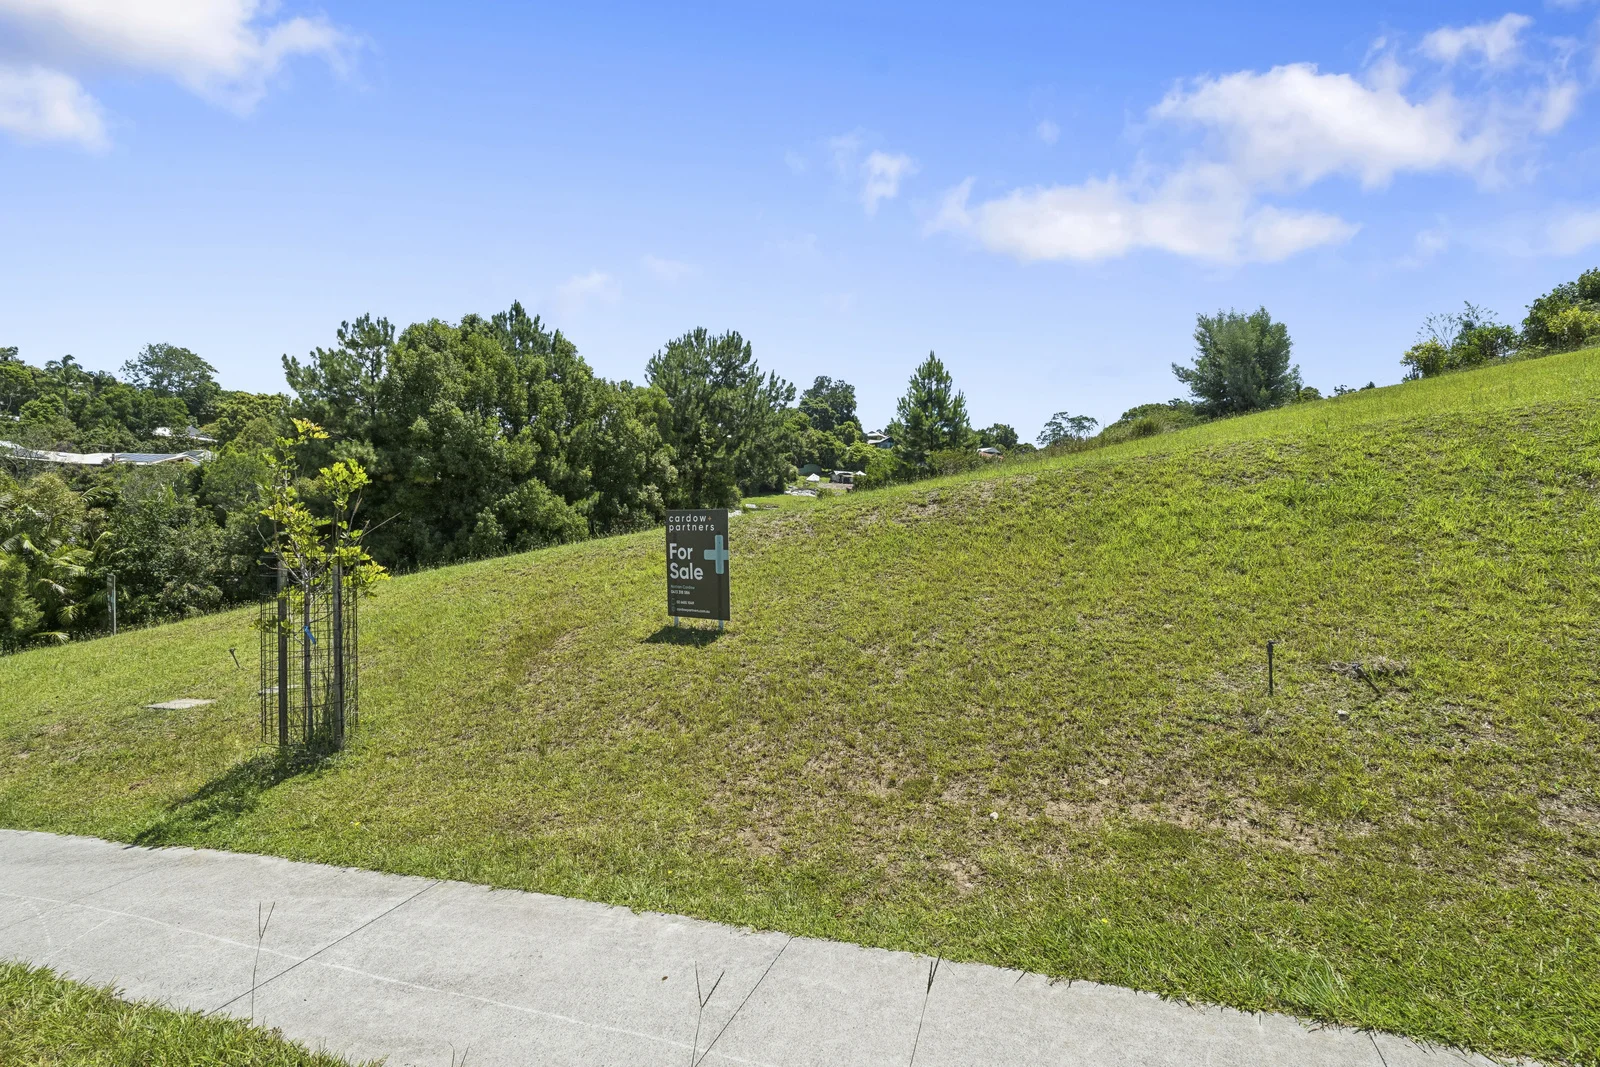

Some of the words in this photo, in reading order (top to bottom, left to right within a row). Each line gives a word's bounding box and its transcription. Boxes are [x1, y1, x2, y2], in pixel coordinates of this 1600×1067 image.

[669, 524, 715, 533] partners
[669, 543, 693, 560] For
[670, 562, 704, 580] Sale
